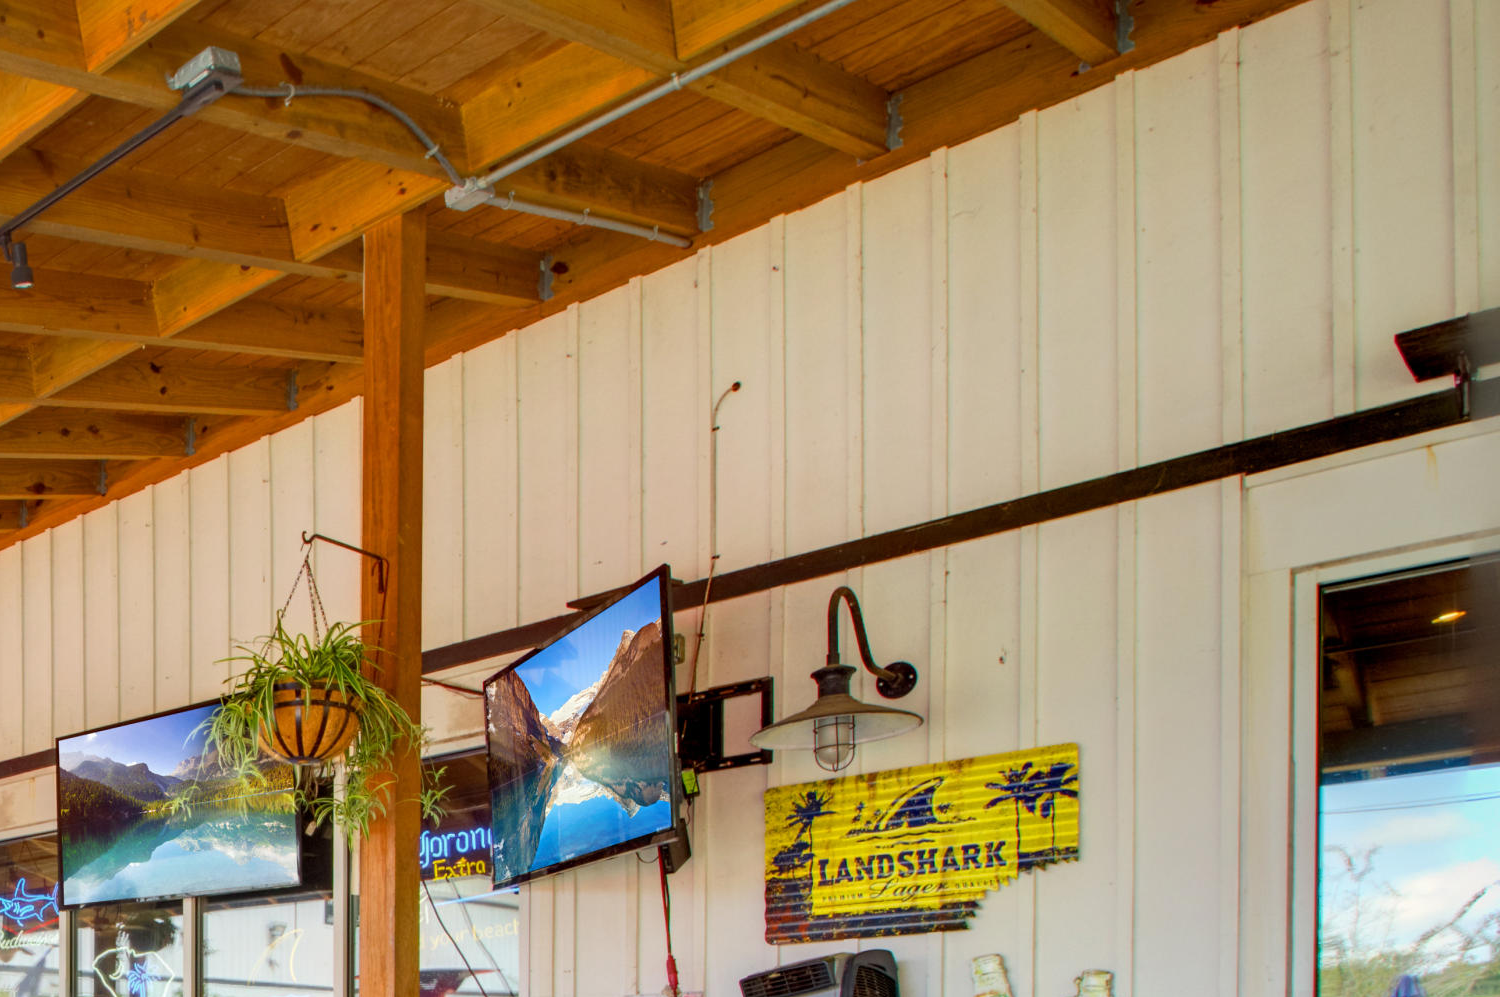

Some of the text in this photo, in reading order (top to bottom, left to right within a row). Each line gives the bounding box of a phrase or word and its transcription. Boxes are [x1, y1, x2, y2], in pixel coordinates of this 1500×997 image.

[433, 858, 486, 881] Extra
[817, 840, 1007, 887] LANDSHARK
[868, 877, 950, 902] Lager
